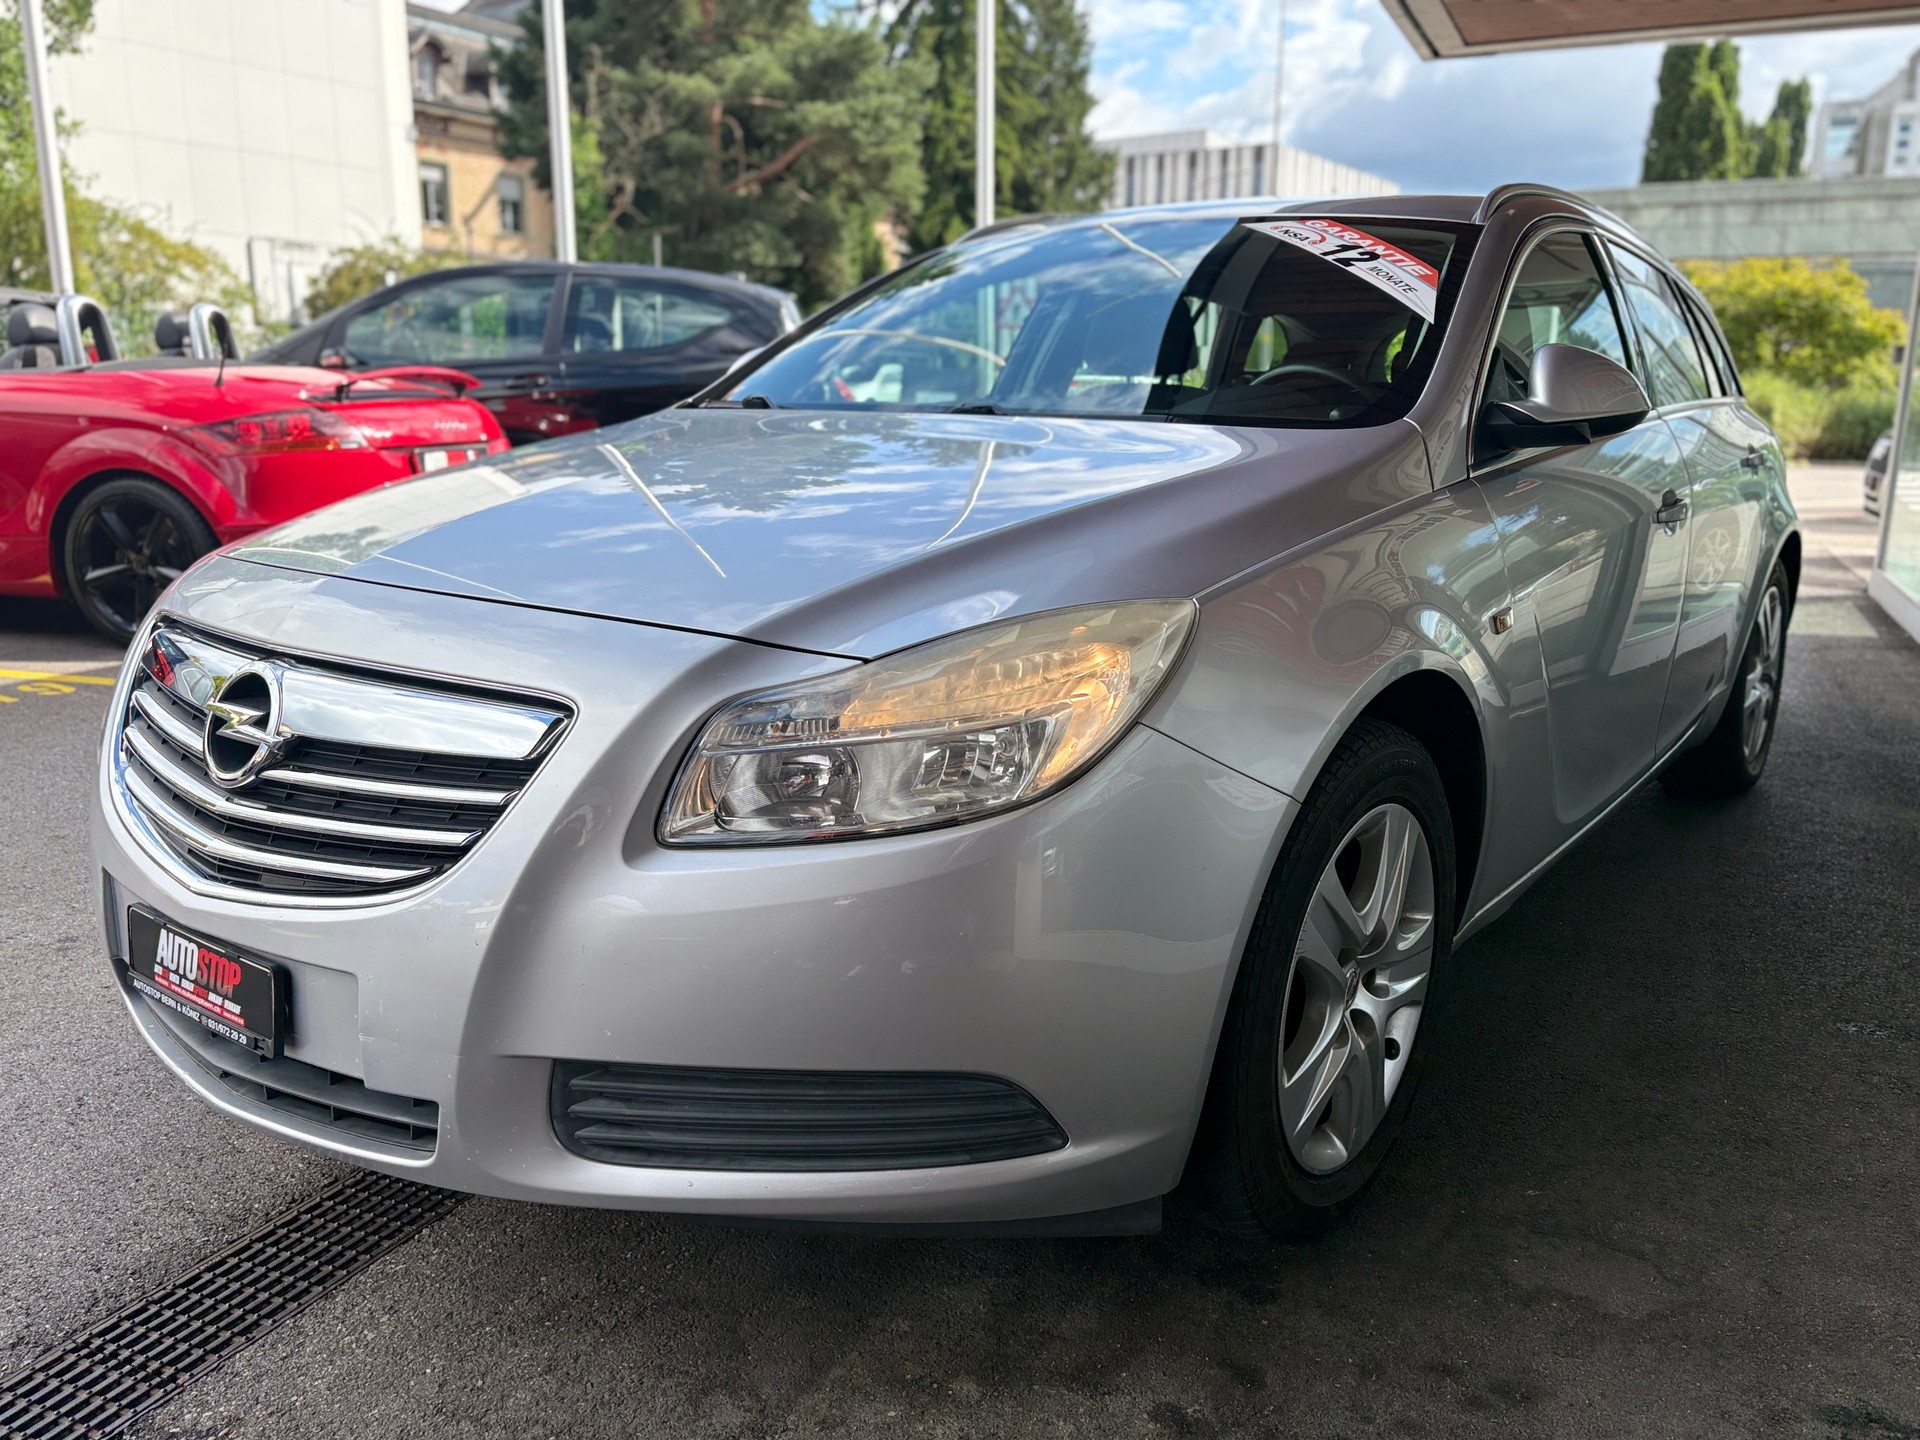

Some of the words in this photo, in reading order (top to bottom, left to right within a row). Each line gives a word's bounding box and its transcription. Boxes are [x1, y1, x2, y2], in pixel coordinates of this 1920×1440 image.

[1278, 229, 1310, 242] NSA
[1305, 220, 1432, 276] GARANTIE
[1320, 243, 1381, 267] 12
[1366, 266, 1419, 294] MONATE
[156, 928, 242, 998] AUTOSTOP
[133, 979, 162, 1000] AUTOSTOP
[161, 994, 177, 1010] BERN
[182, 1003, 201, 1022] KÖNIZ
